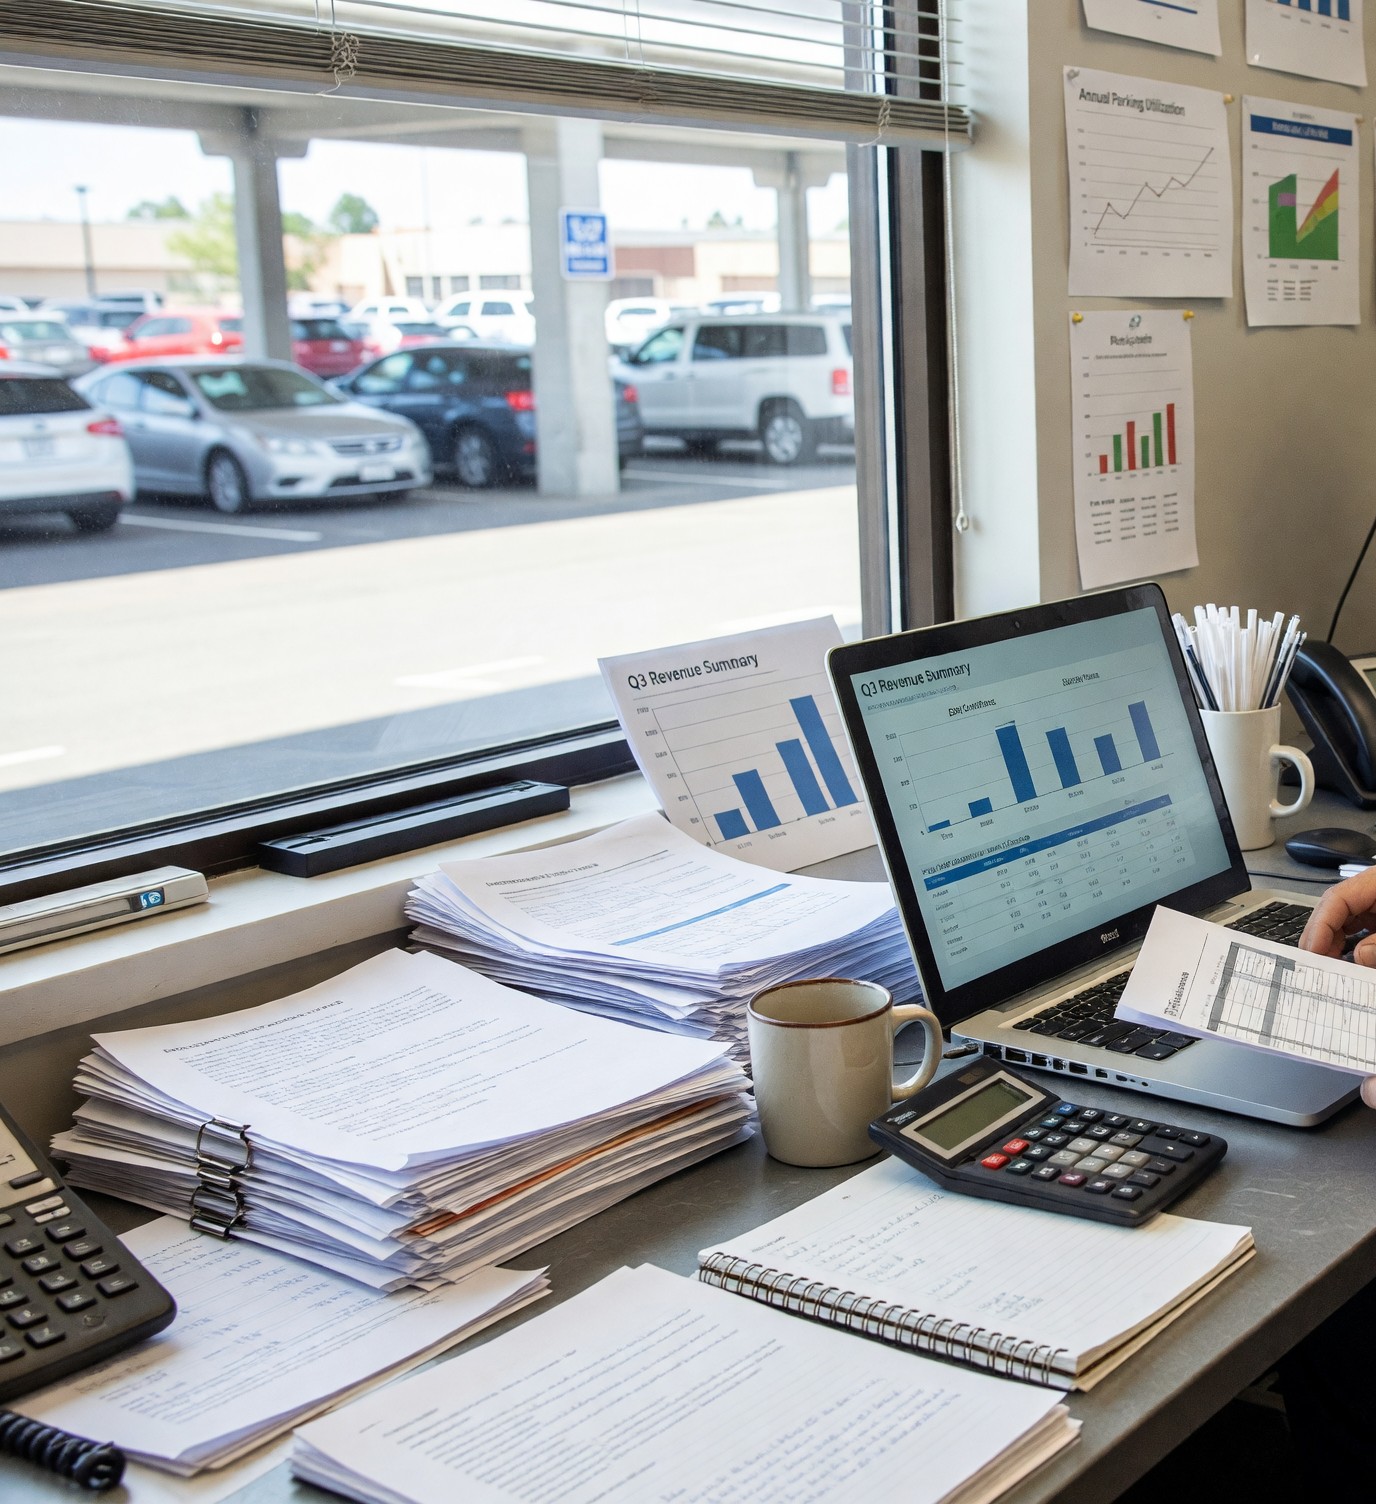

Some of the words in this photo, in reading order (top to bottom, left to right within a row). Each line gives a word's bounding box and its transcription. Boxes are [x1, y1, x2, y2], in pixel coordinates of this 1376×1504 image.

[1079, 88, 1110, 104] Annual
[1112, 92, 1144, 113] Parking
[628, 674, 648, 690] Q3
[649, 665, 702, 686] Revenue
[861, 681, 878, 697] Q3
[878, 673, 925, 693] Revenue
